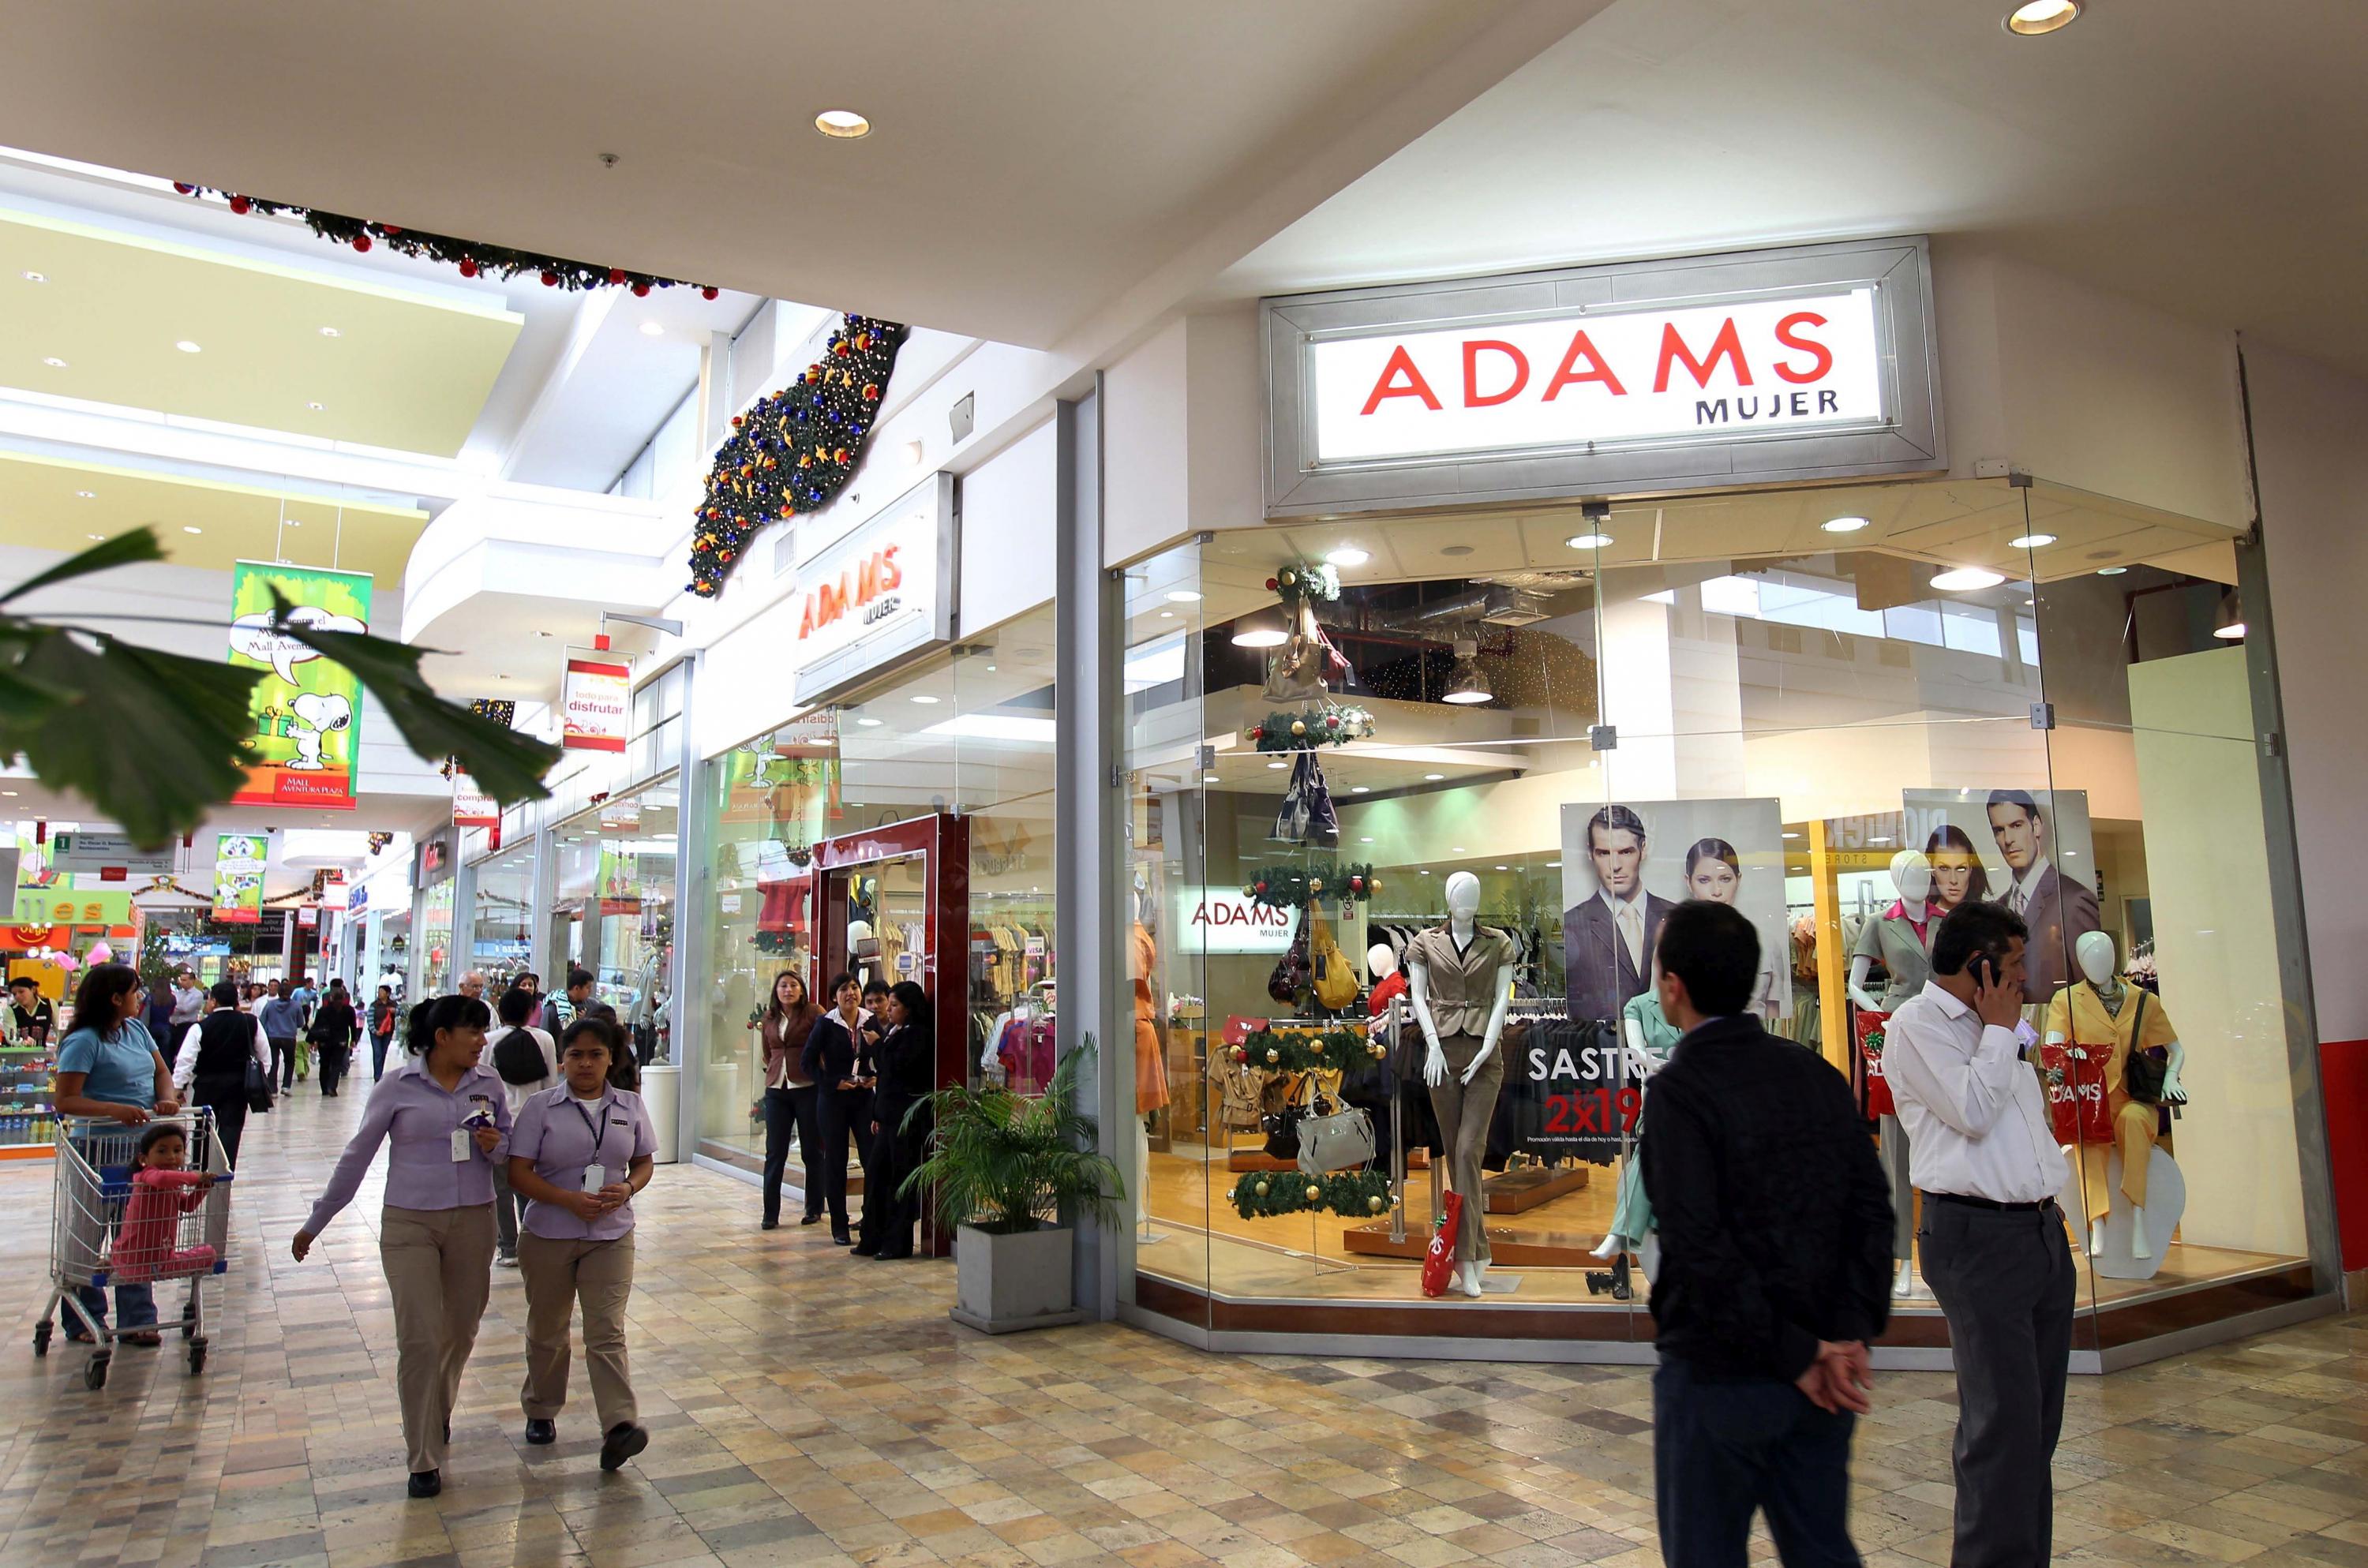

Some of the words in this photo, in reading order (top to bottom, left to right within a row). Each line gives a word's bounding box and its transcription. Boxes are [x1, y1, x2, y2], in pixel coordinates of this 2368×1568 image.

[1360, 312, 1834, 416] ADAMS
[1695, 390, 1839, 425] MUJER
[798, 542, 901, 640] ADAMS
[863, 596, 901, 626] MUJER
[247, 642, 272, 652] Mall
[569, 700, 624, 715] disfrutar
[287, 777, 309, 786] MALL
[59, 838, 66, 848] 1
[1191, 901, 1289, 926] ADAMS
